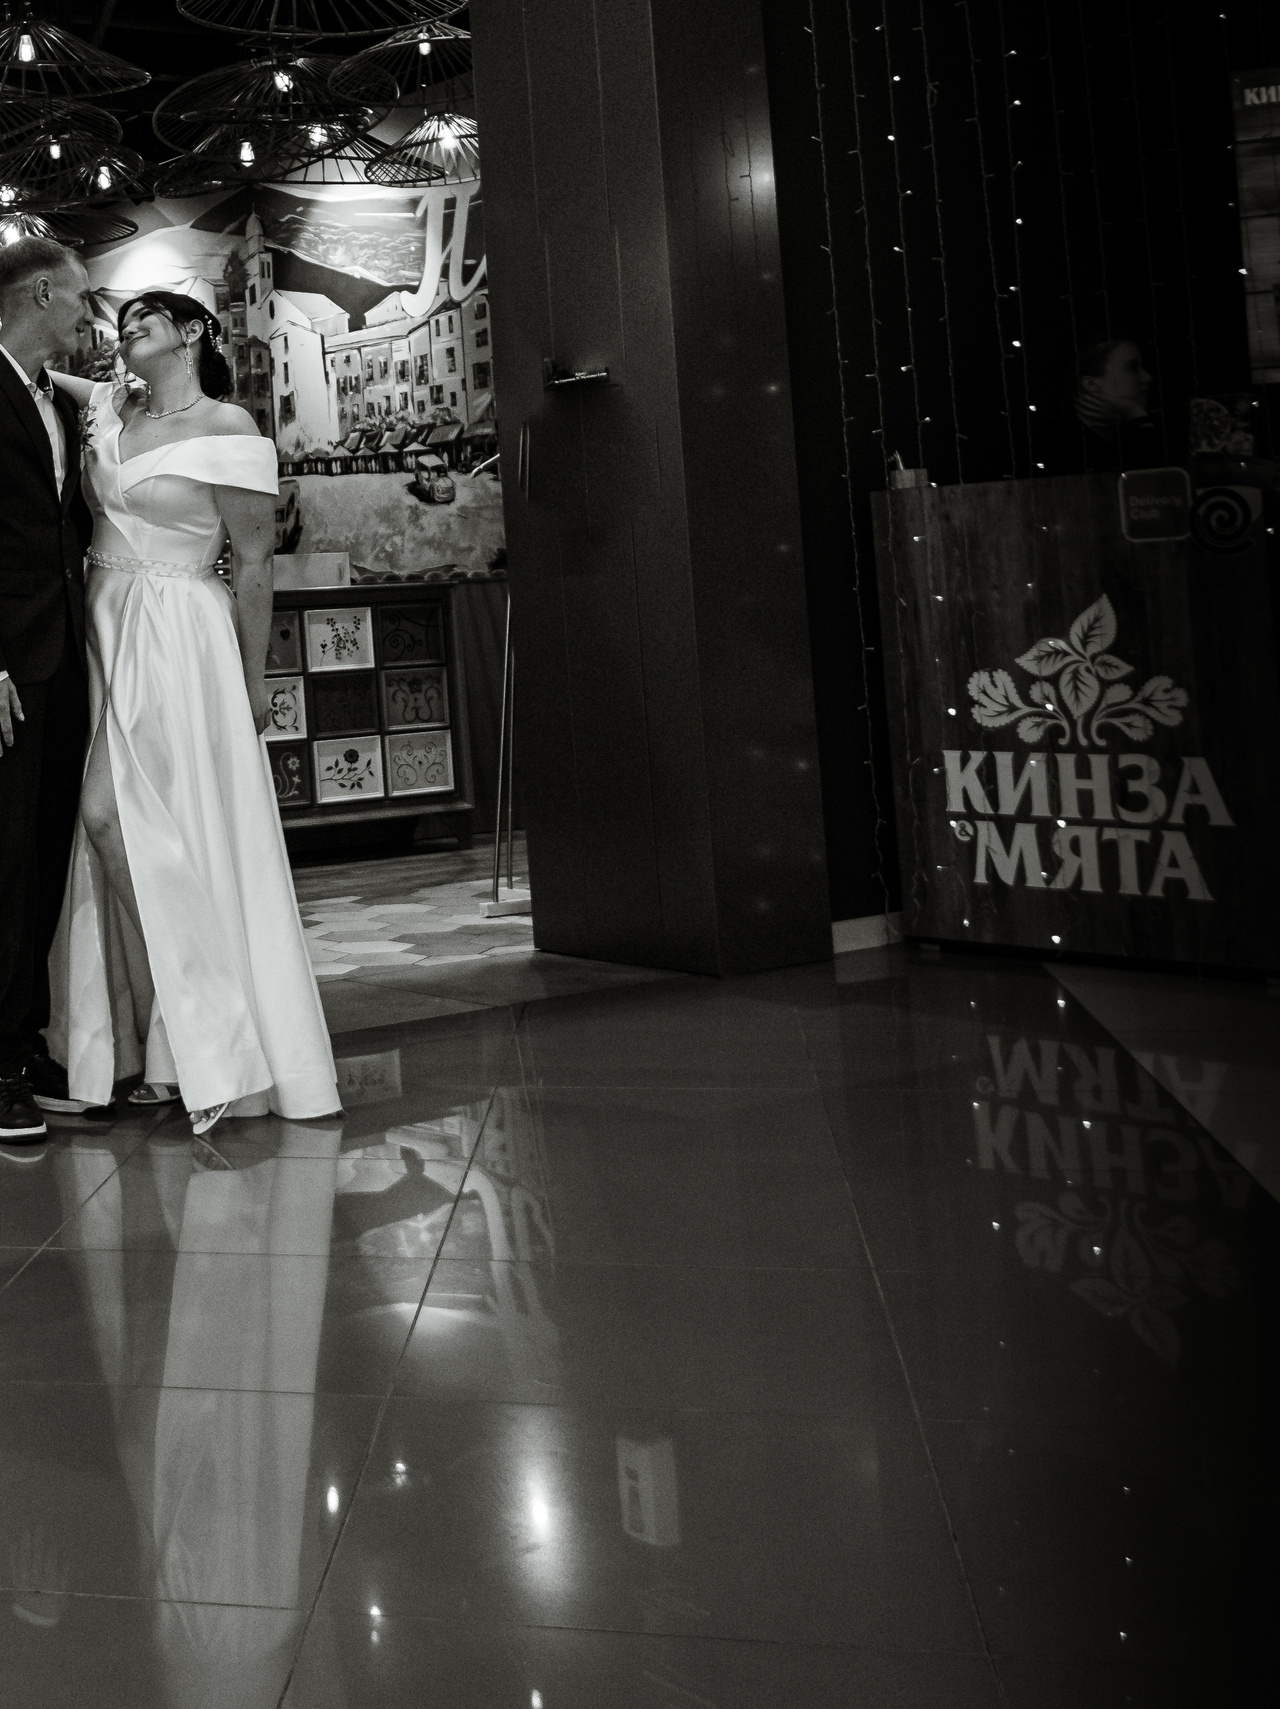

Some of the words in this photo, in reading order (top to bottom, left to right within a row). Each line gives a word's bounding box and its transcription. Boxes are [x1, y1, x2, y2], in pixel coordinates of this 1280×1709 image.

[1243, 84, 1280, 106] КИ
[1130, 508, 1160, 519] Club
[942, 749, 1237, 827] КИНЗА
[973, 820, 1217, 901] МЯТА
